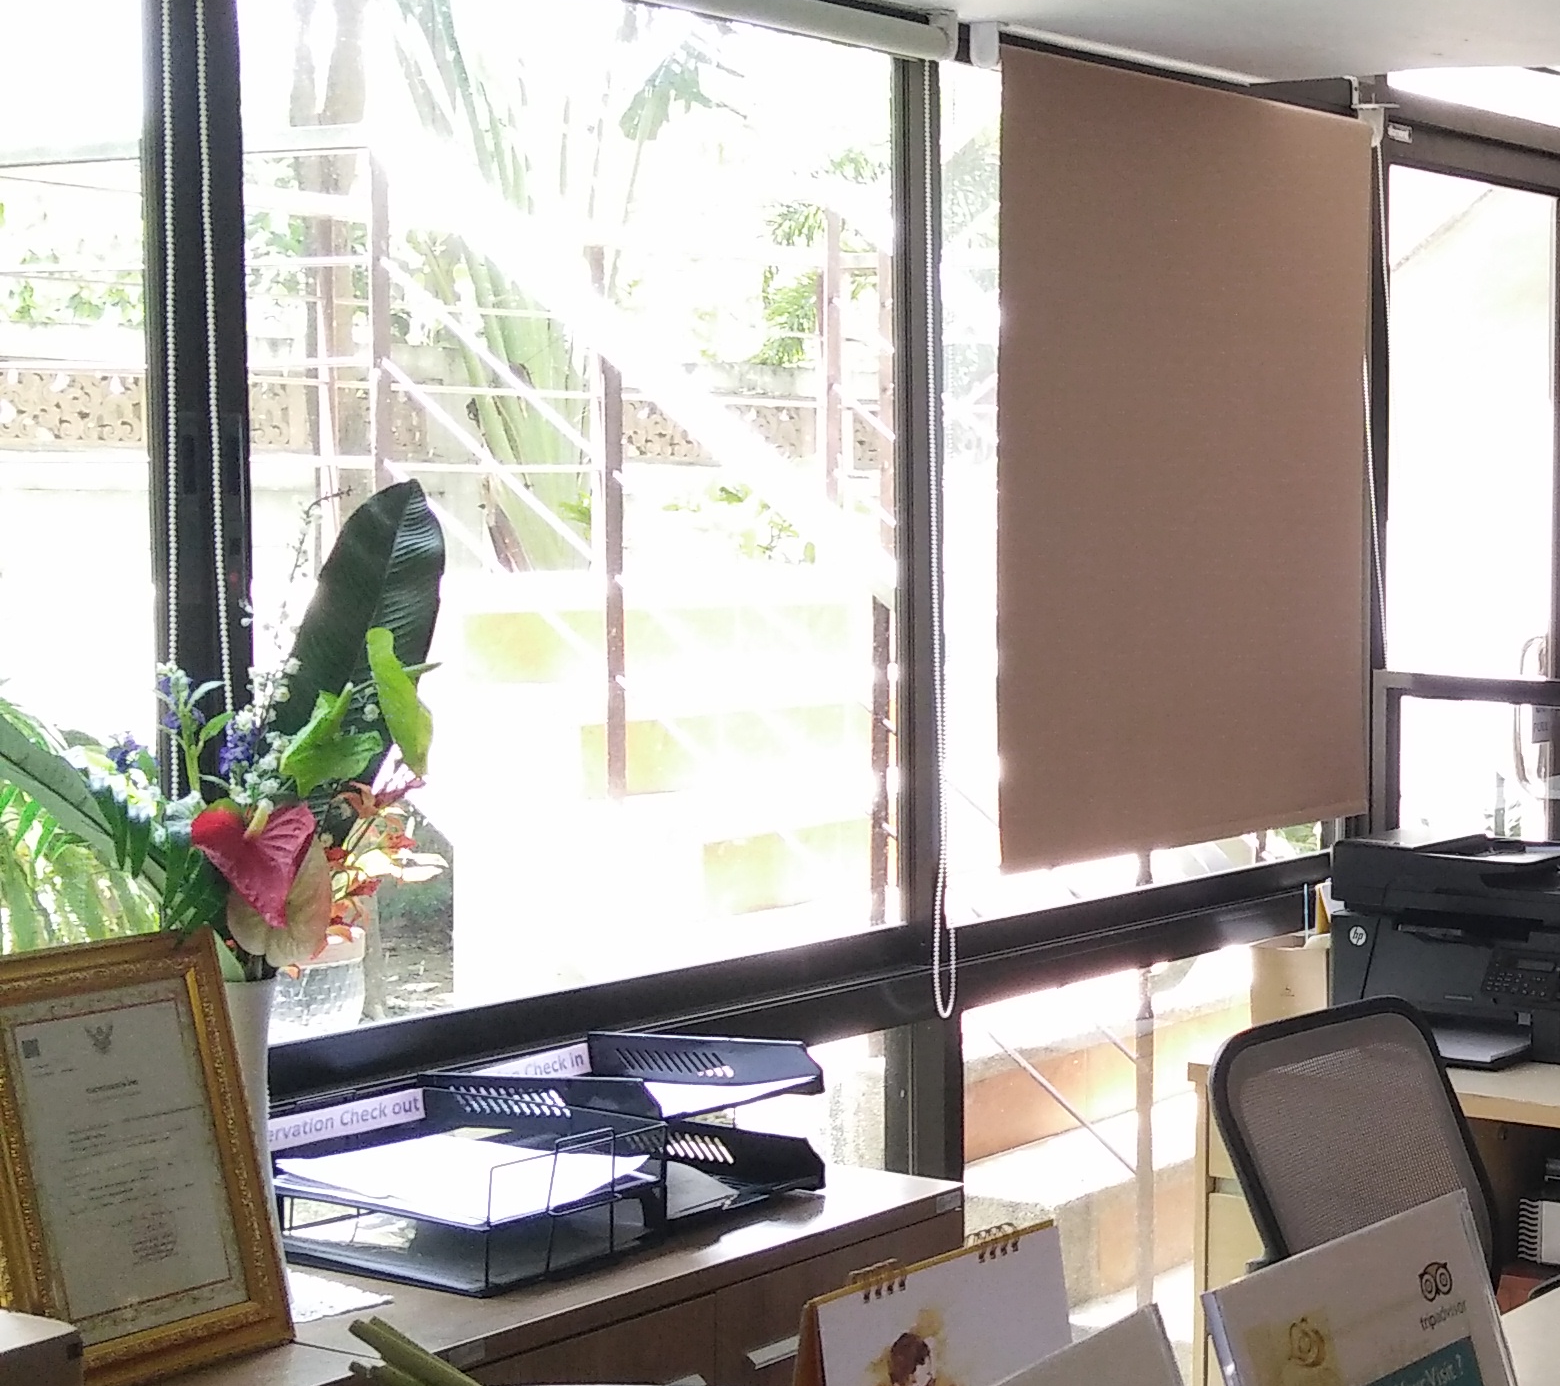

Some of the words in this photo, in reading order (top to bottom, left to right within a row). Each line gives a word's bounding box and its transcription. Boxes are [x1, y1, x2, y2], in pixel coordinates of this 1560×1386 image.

[523, 1057, 567, 1077] Check
[569, 1053, 584, 1068] in
[266, 1115, 334, 1144] ervation
[340, 1101, 388, 1127] Check
[392, 1095, 421, 1116] out
[1420, 1300, 1467, 1331] tripadvisor
